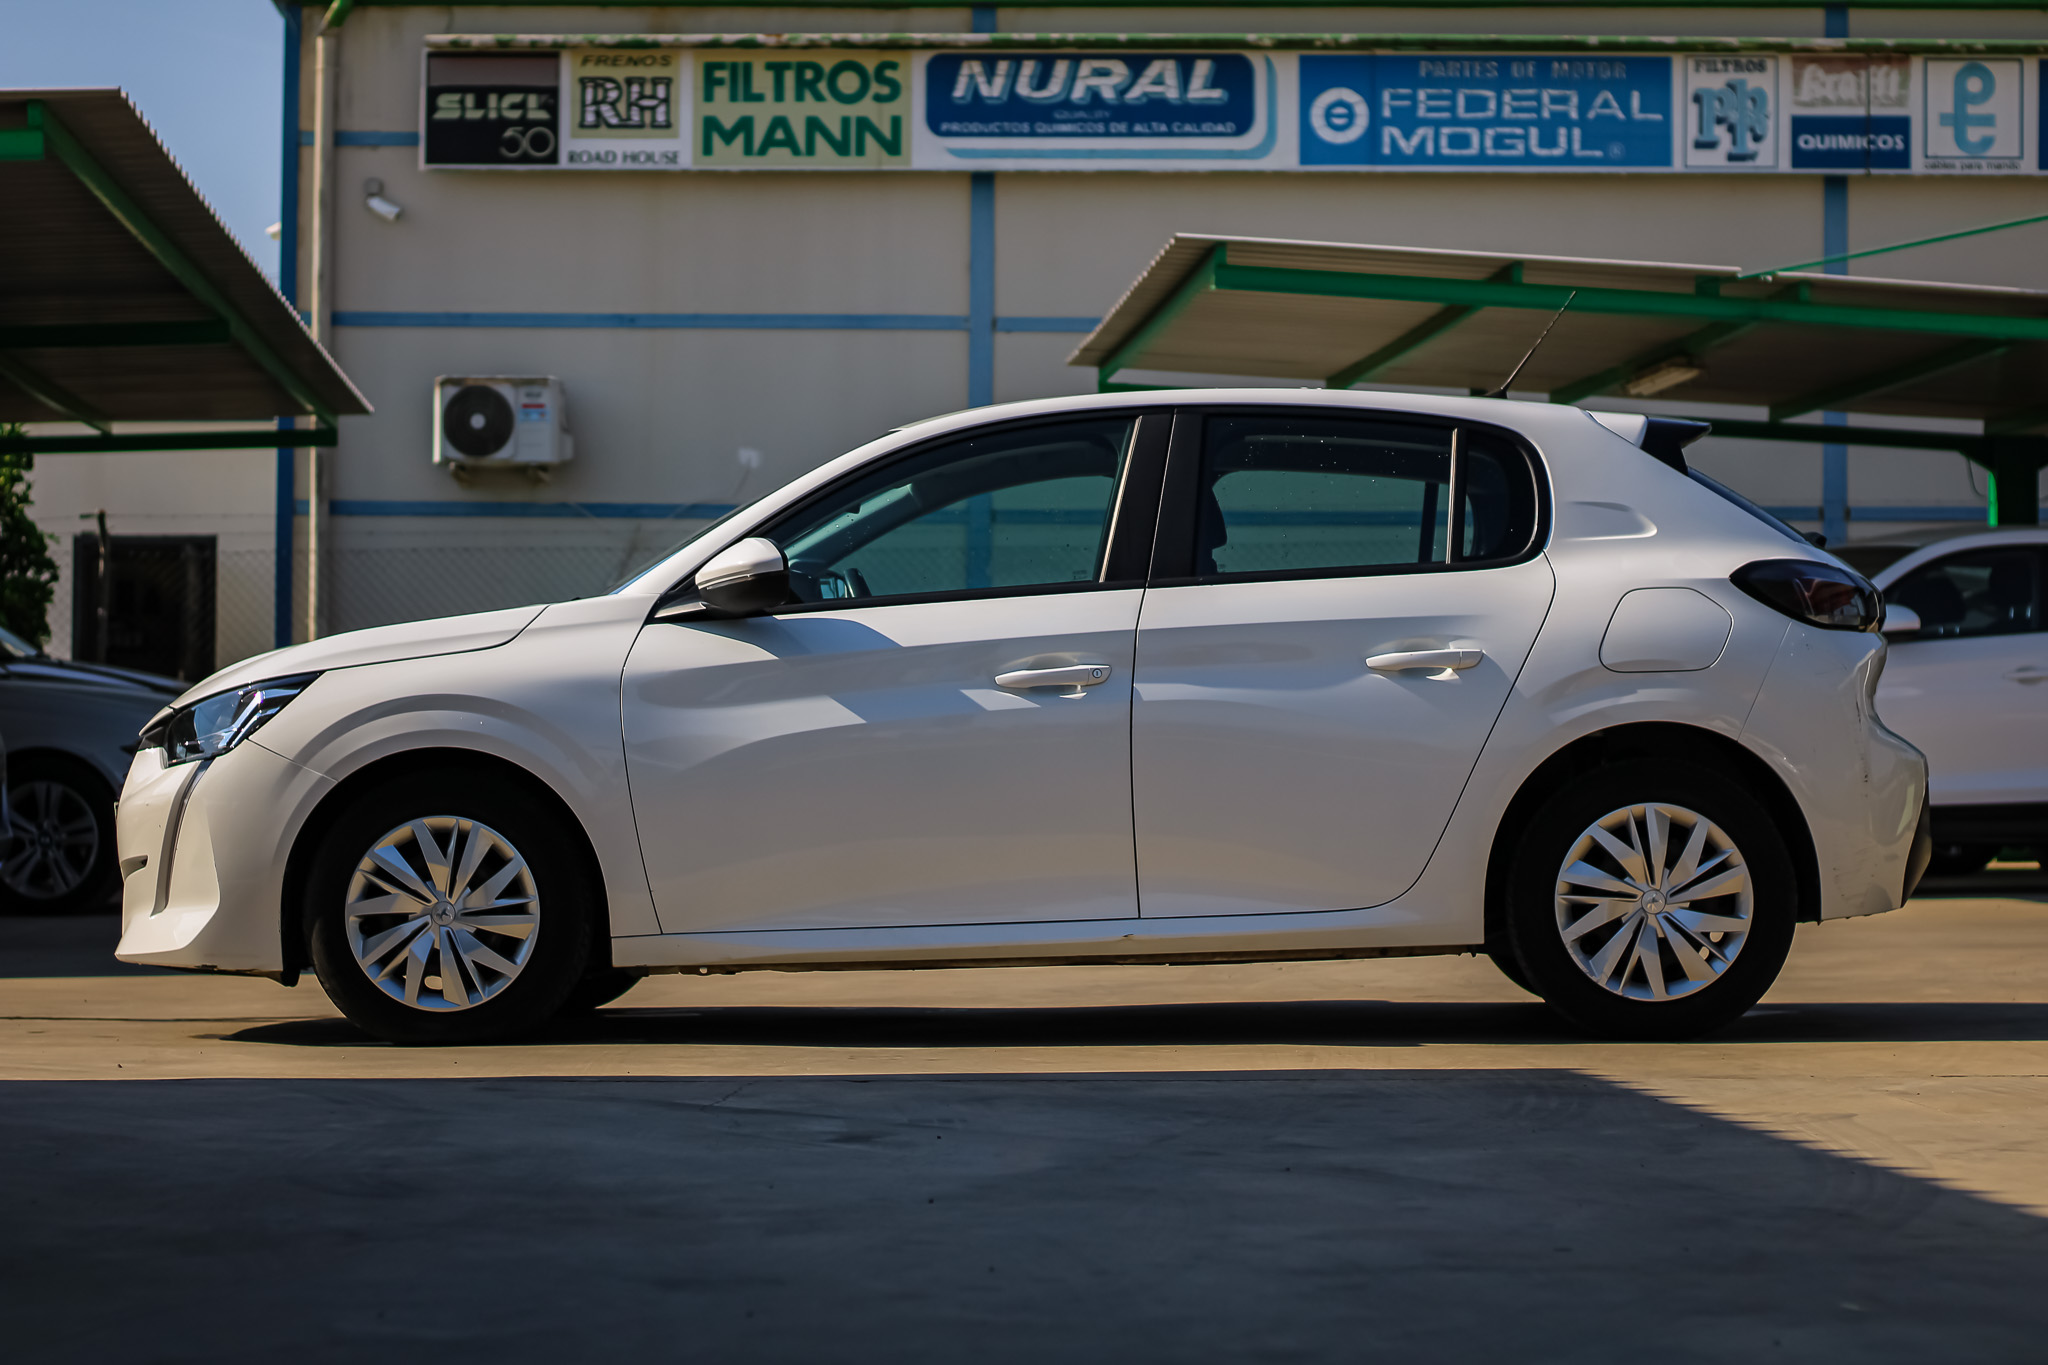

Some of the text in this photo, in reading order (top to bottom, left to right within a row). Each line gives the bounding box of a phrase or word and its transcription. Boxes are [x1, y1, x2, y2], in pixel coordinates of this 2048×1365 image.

[581, 54, 672, 67] FRENOS
[1419, 60, 1627, 79] PARTES DE MOTOR
[1694, 58, 1768, 73] FILTROS
[703, 60, 902, 105] FILTROS
[953, 59, 1228, 104] NURAL
[578, 77, 673, 129] RH
[1382, 88, 1664, 121] FEDERAL
[500, 126, 556, 158] 50
[702, 115, 902, 157] MANN
[940, 121, 1031, 134] PRODUCTOS
[1108, 121, 1129, 134] DE
[1132, 121, 1169, 134] ALTA
[1171, 121, 1237, 134] CALIDAD
[1382, 126, 1604, 157] MOGUL
[1797, 133, 1905, 151] QUIMICOS
[567, 150, 680, 165] ROAD HOUSE
